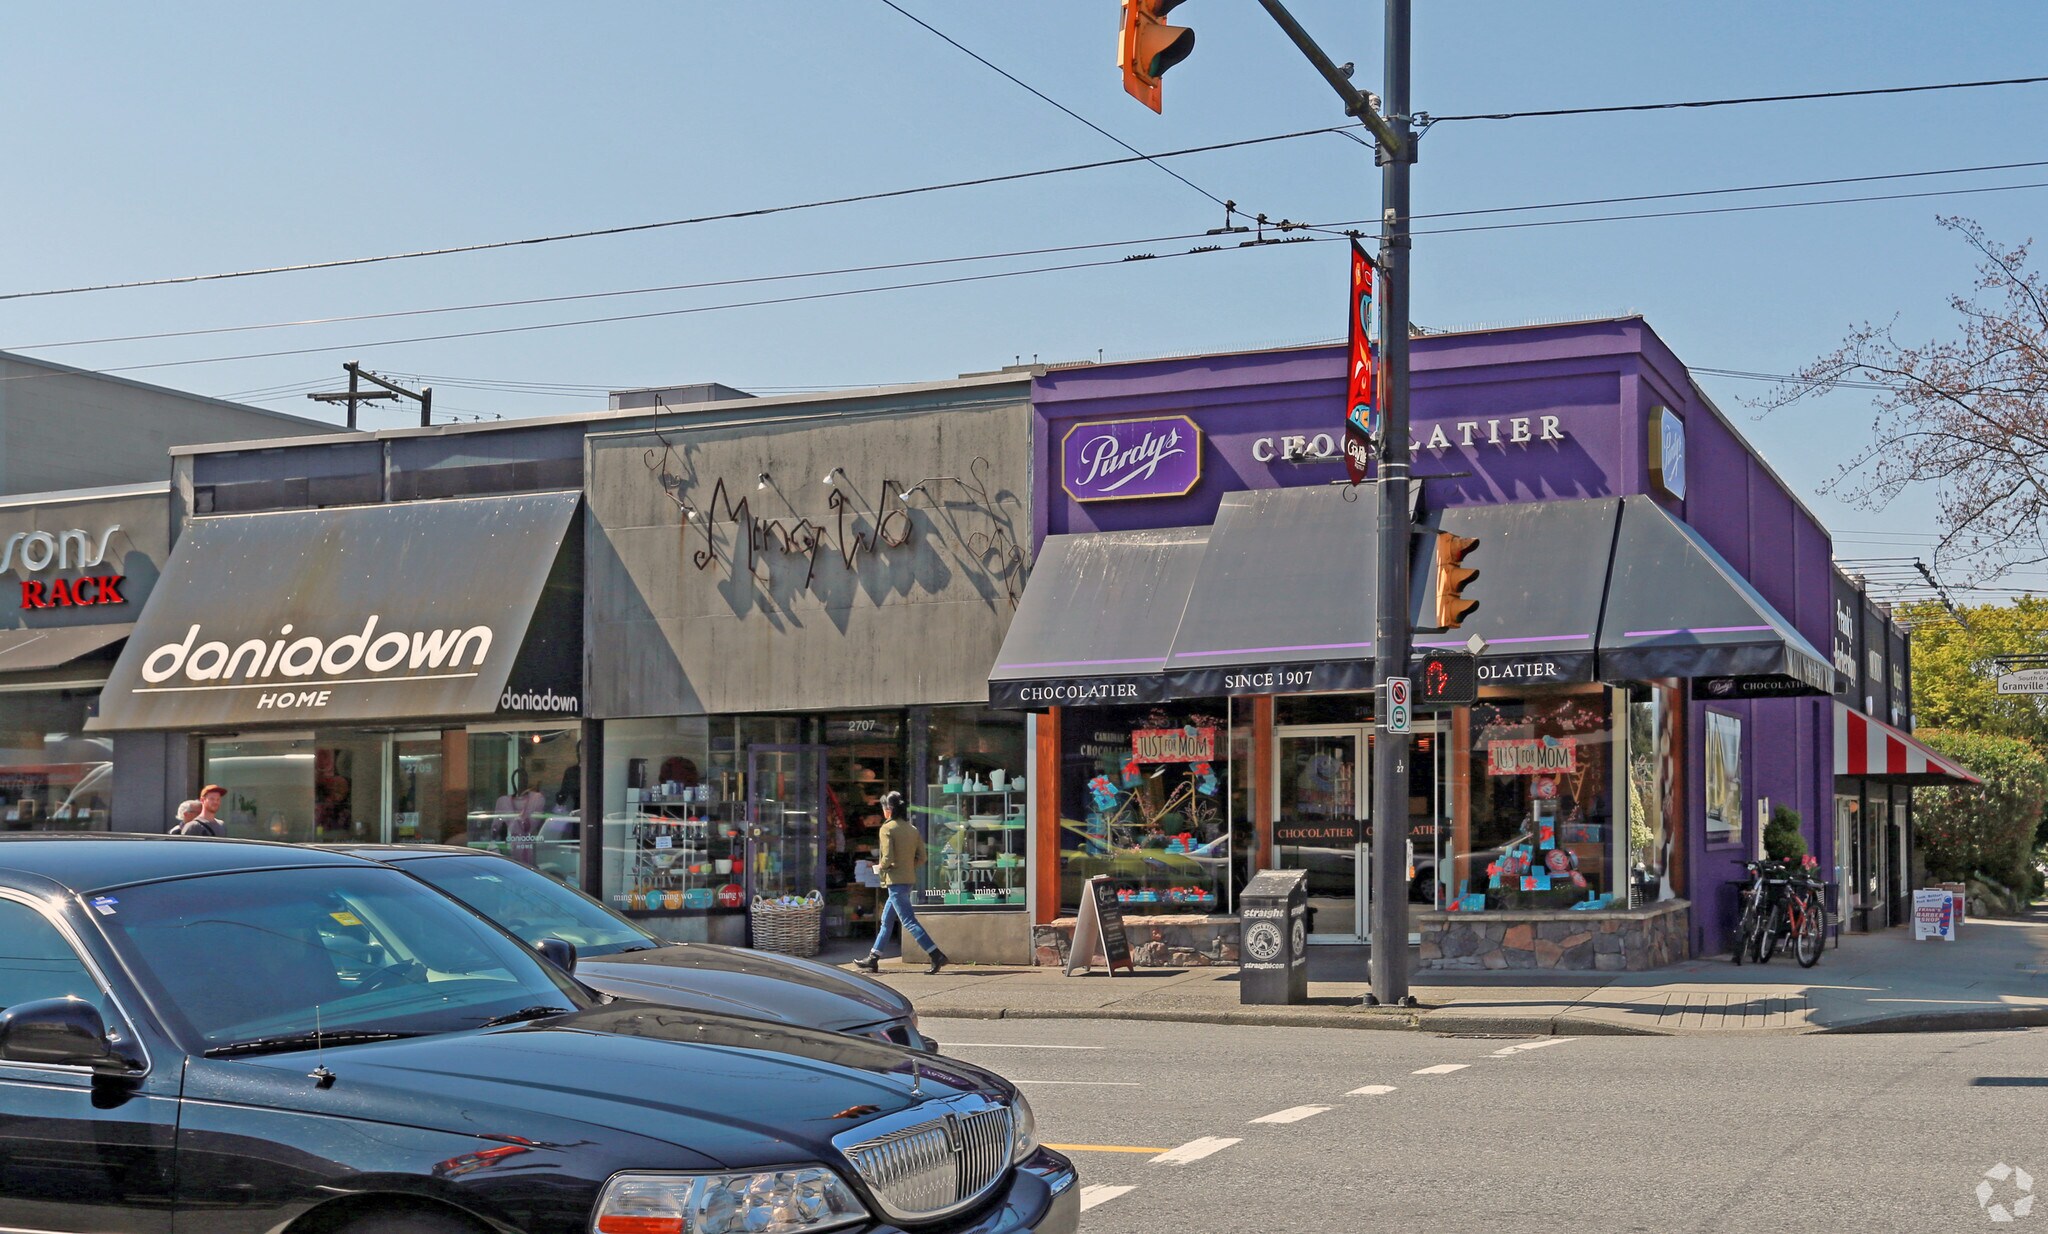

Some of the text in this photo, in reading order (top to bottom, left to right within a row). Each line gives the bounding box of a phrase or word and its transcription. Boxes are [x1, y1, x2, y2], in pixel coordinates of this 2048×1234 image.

[19, 575, 127, 610] RACK
[141, 615, 493, 684] daniadown
[1477, 662, 1557, 680] OLATIER
[1225, 671, 1313, 689] SINCE 1907
[2002, 682, 2044, 691] Granville
[257, 690, 331, 709] HOME
[501, 686, 577, 713] daniadown
[1020, 684, 1138, 701] CHOCOLATIER
[848, 720, 875, 732] 2707
[1139, 736, 1162, 758] JUST
[1164, 739, 1177, 751] FOR
[1178, 735, 1207, 756] MOM
[1496, 747, 1568, 769] JUST FOR MOM
[1277, 828, 1354, 839] CHOCOLATIER
[613, 893, 633, 902] ming
[659, 892, 679, 901] ming
[718, 890, 737, 900] ming
[925, 887, 946, 898] ming
[975, 886, 1011, 897] ming wo
[1243, 908, 1284, 918] straight
